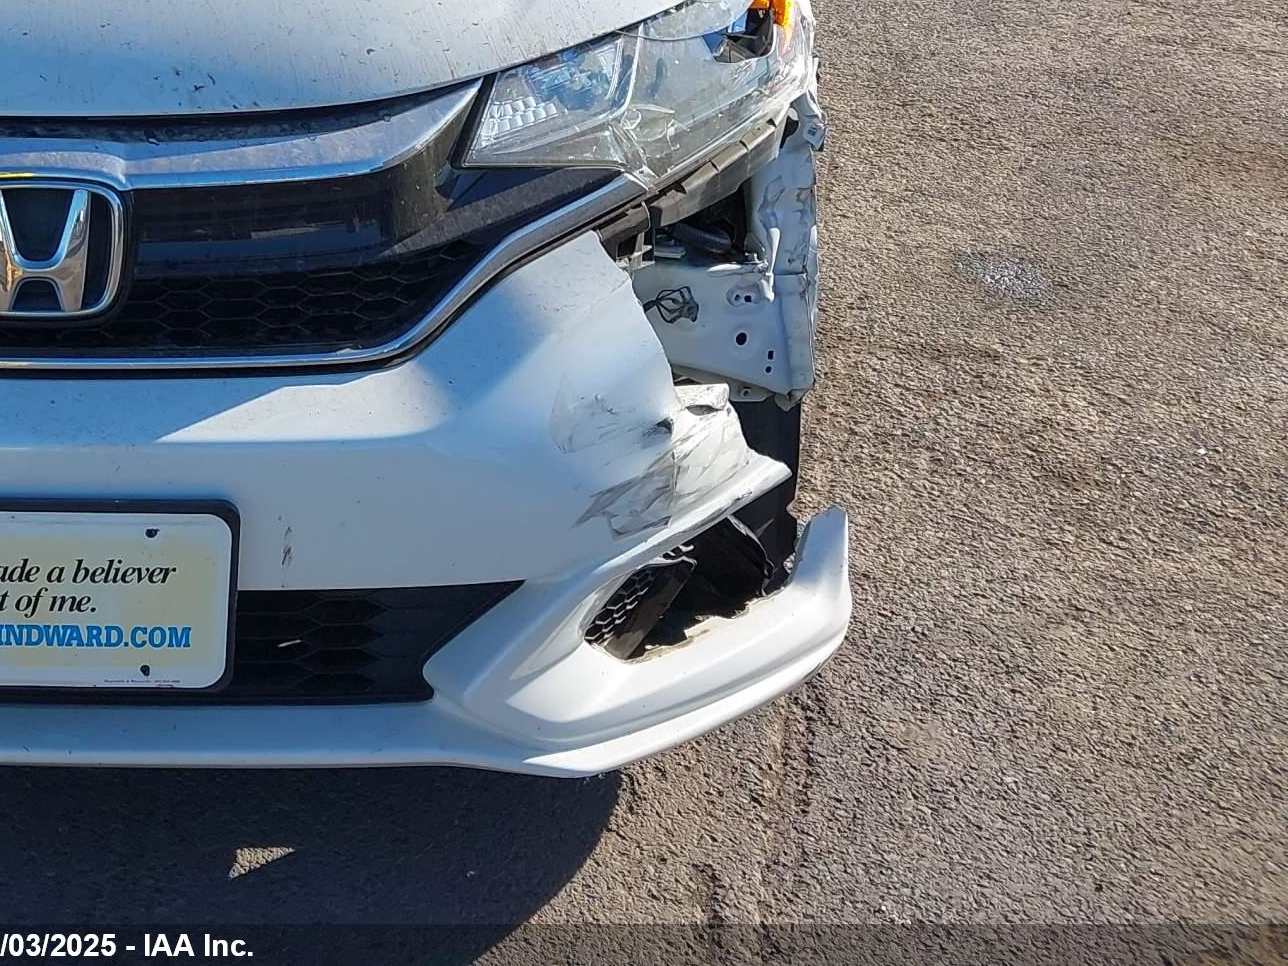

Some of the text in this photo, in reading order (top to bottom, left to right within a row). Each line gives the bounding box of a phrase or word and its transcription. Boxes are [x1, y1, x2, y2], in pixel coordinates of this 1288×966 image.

[46, 565, 66, 584] a
[71, 559, 177, 585] believer
[14, 586, 48, 619] of
[49, 595, 97, 613] me.
